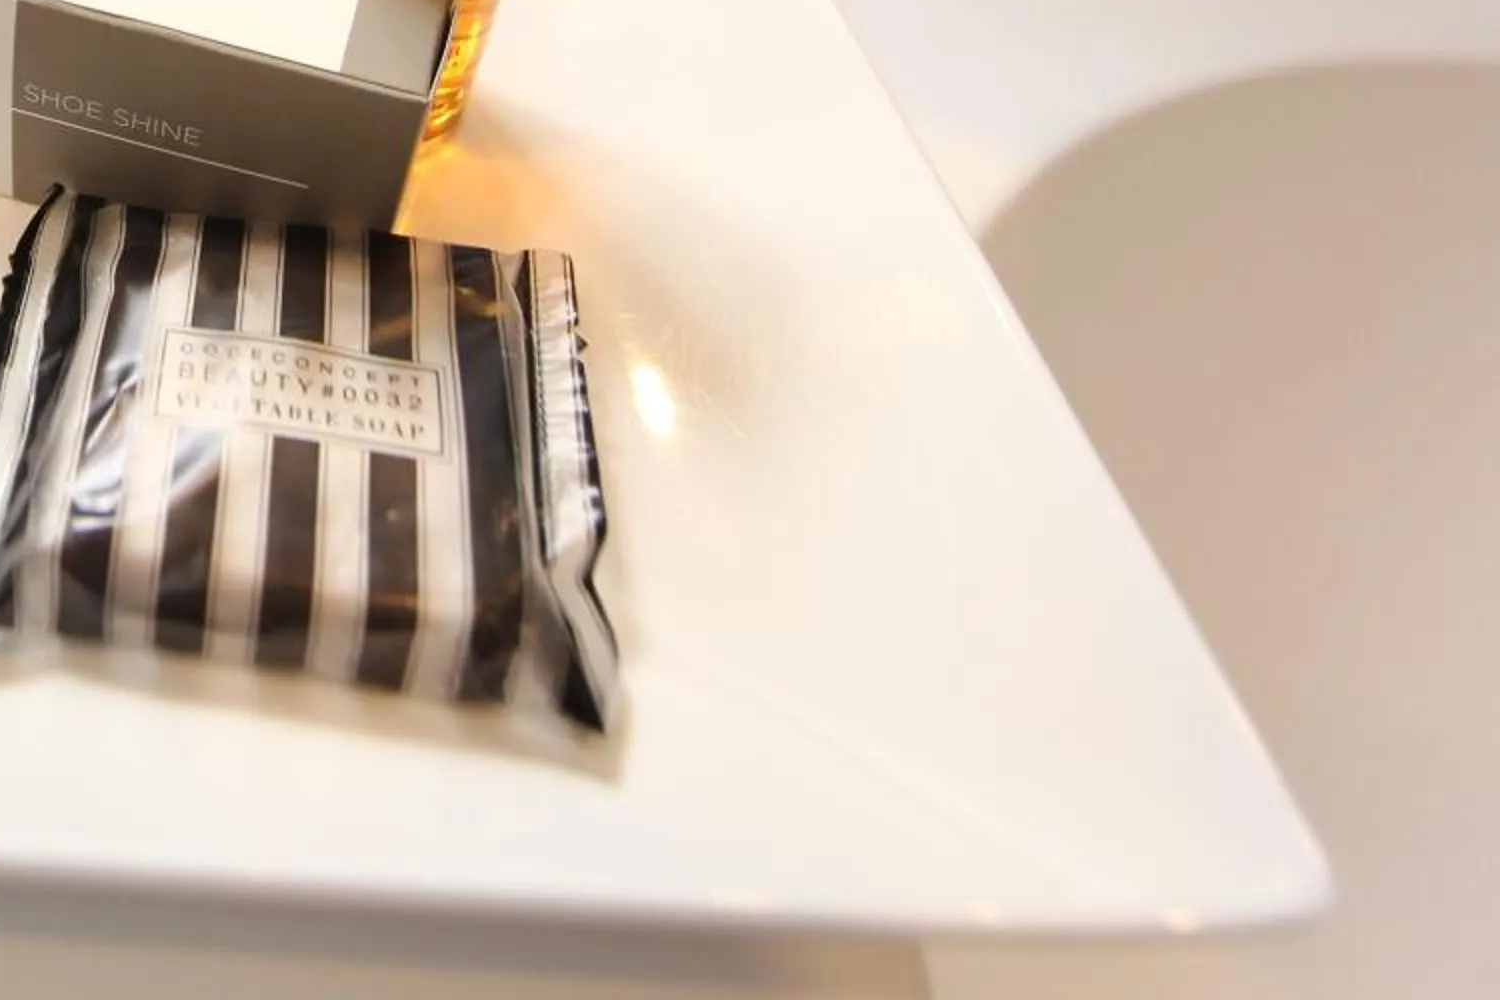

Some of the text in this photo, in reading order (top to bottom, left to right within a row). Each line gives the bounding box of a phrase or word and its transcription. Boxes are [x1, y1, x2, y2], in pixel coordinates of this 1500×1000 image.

[21, 82, 204, 147] SHOE SHINE
[175, 392, 425, 441] VETABLE SOAP
